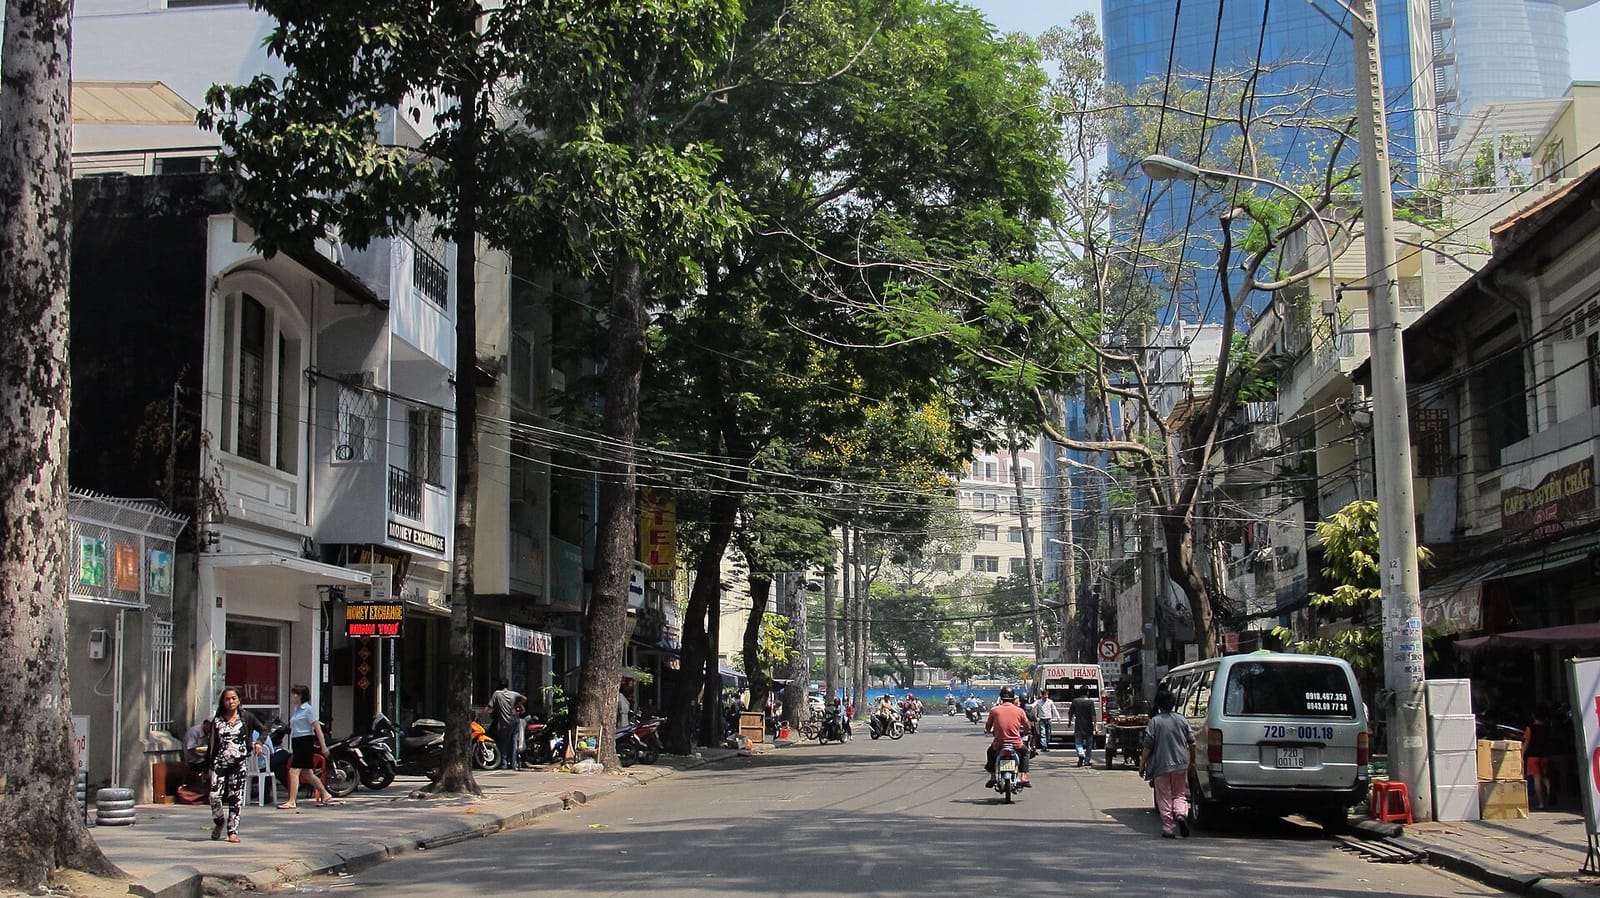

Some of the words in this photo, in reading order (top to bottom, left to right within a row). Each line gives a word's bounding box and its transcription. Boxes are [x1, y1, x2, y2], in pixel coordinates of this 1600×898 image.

[389, 523, 413, 542] MONEY
[413, 530, 445, 551] EXCHANGE
[346, 605, 369, 620] MONEY
[370, 605, 403, 620] EXCHANGE
[1264, 725, 1285, 739] 72D
[1298, 726, 1333, 740] 001.18
